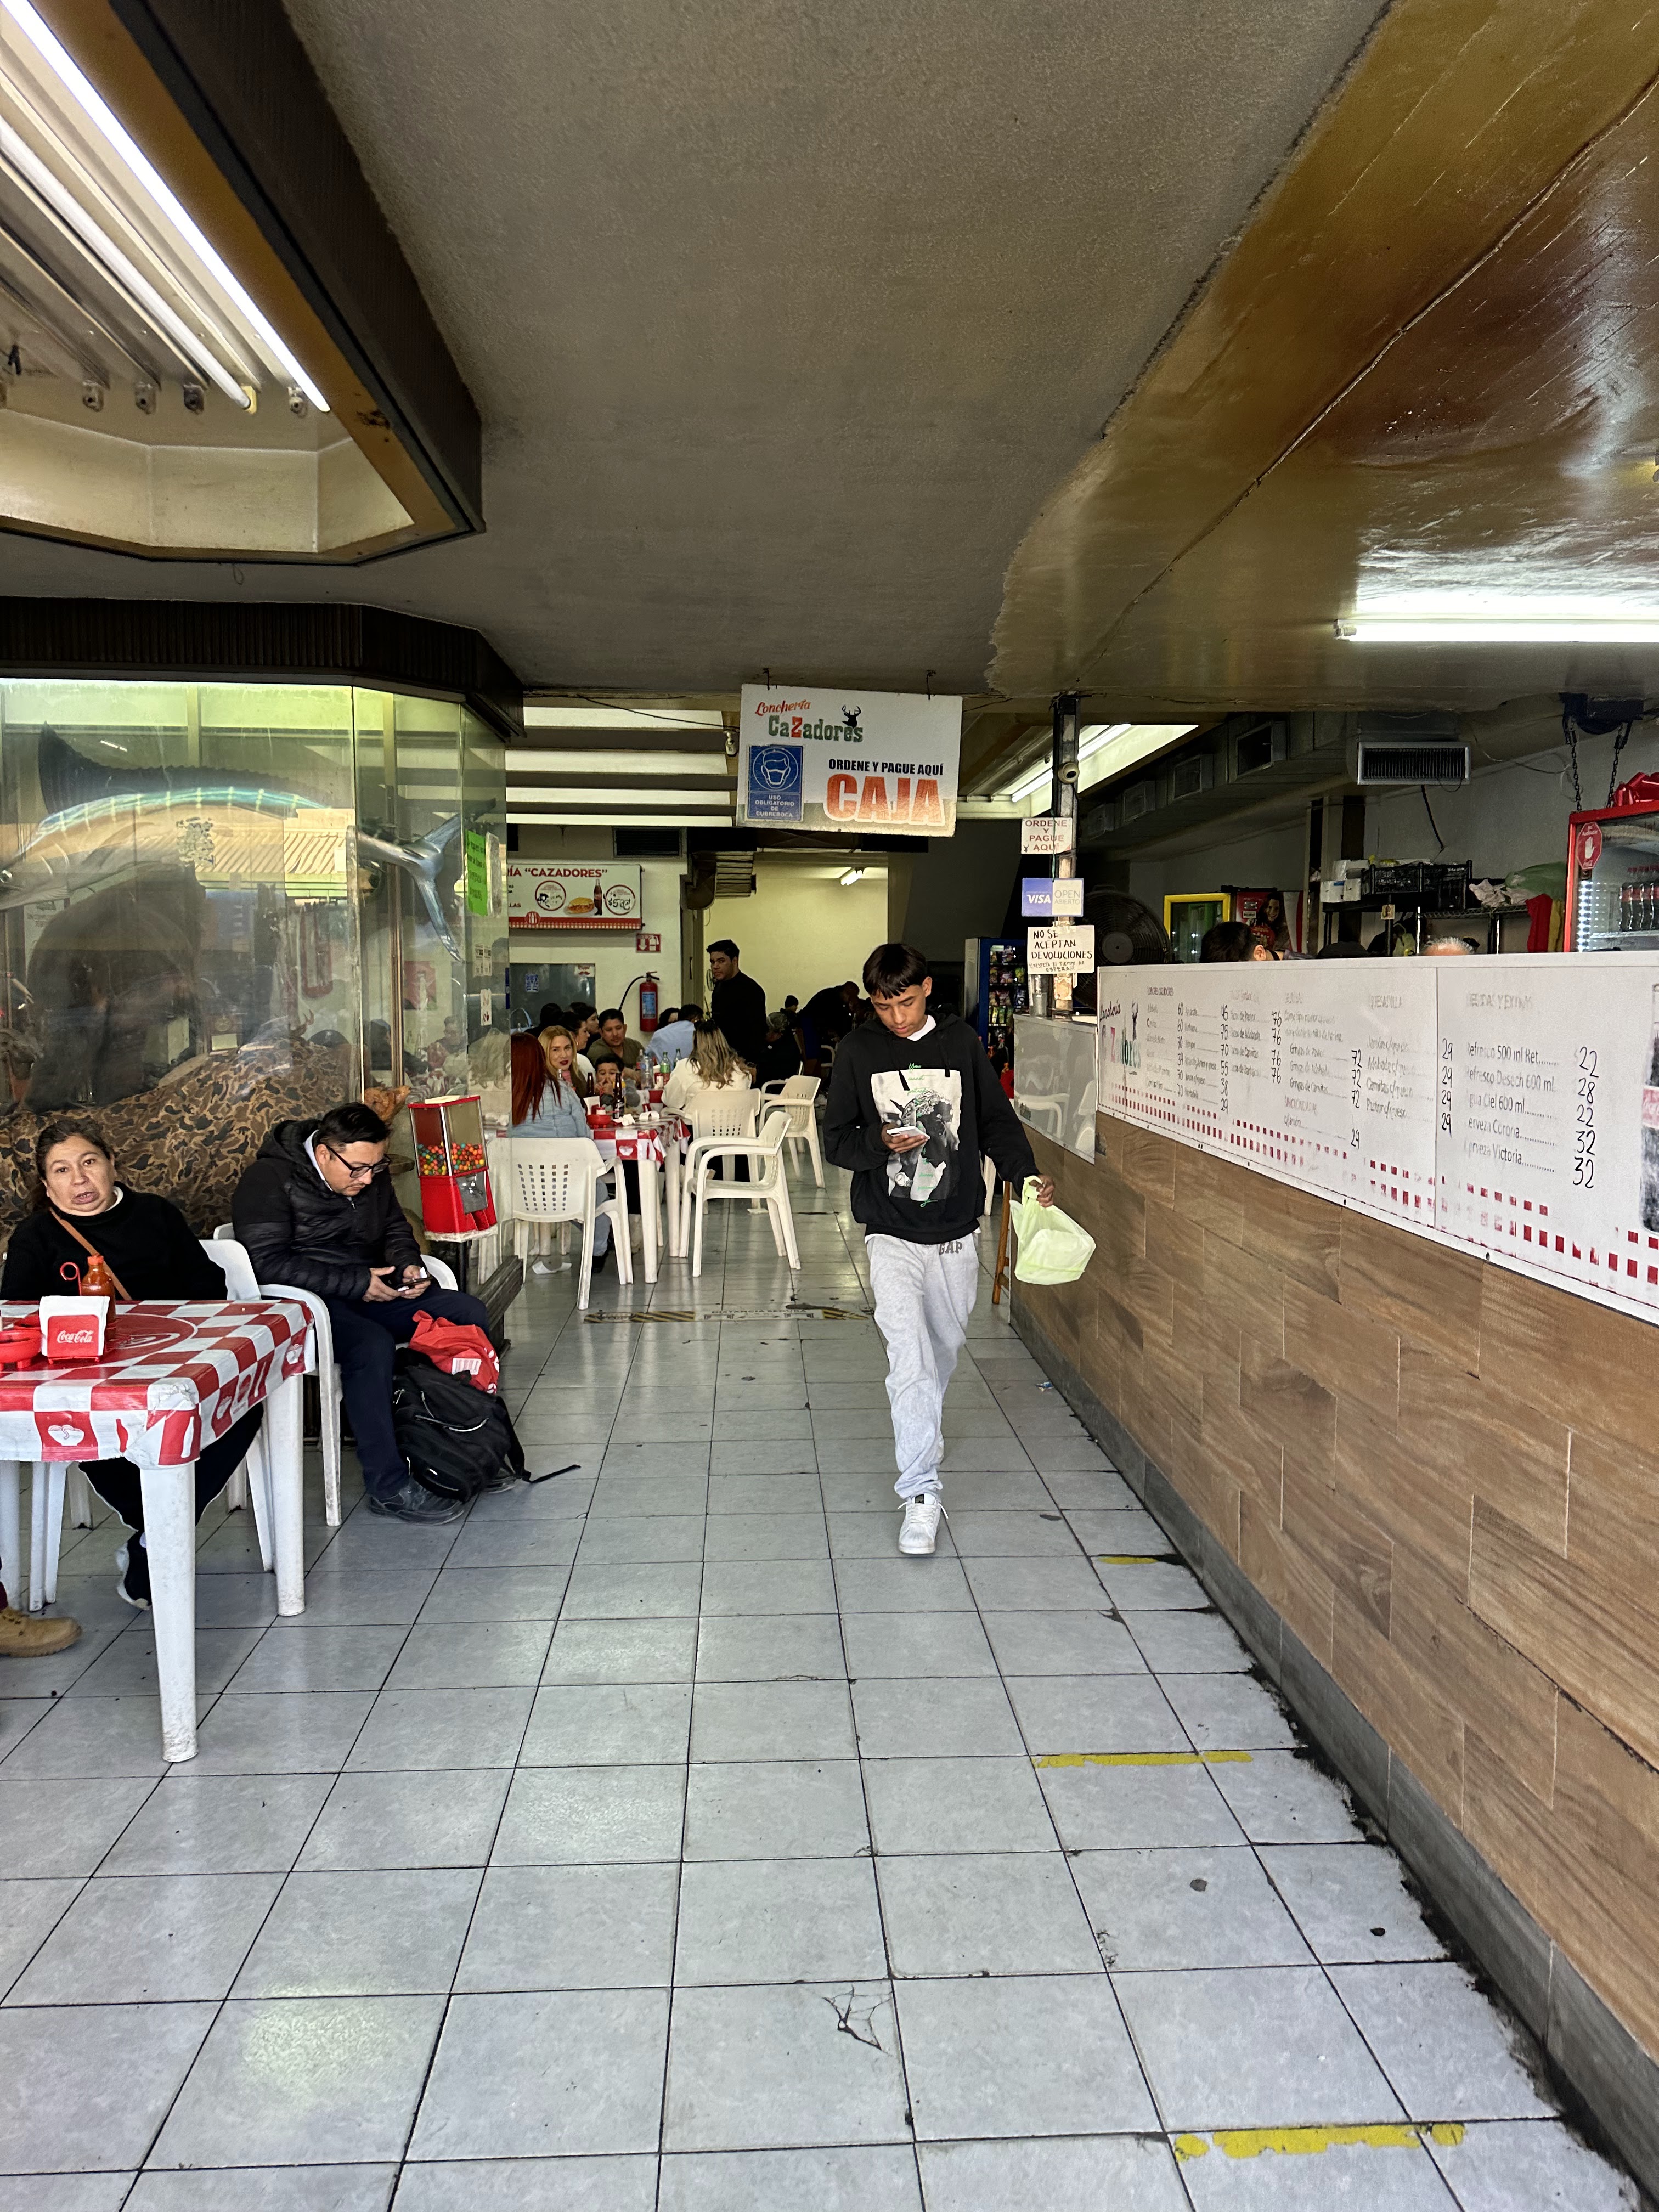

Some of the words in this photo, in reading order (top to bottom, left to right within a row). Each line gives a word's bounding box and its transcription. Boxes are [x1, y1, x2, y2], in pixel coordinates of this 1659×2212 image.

[755, 699, 811, 716] Lonchería
[768, 715, 864, 742] CaZadores
[828, 759, 870, 772] ORDENE
[872, 762, 879, 772] Y
[882, 763, 915, 774] PAGUE
[917, 763, 944, 776] AQUÍ
[826, 773, 943, 823] CAJA
[1027, 894, 1051, 904] VISA
[1054, 890, 1080, 899] OPEN
[1034, 930, 1045, 939] NO
[1047, 929, 1058, 939] SE
[1034, 939, 1076, 949] ACEPTAN
[1031, 951, 1092, 960] DEVOLUCIONES
[1178, 1002, 1184, 1016] 60
[1177, 1019, 1183, 1032] 60
[1271, 1011, 1282, 1027] 76
[1221, 1024, 1228, 1040] 75
[1271, 1028, 1281, 1045] 76
[1177, 1035, 1183, 1050] 70
[1221, 1043, 1229, 1056] 70
[1442, 1038, 1453, 1061] 29
[1467, 1041, 1496, 1059] Refreo
[1497, 1045, 1511, 1061] 500
[1271, 1050, 1281, 1066] 76
[1351, 1049, 1362, 1068] 72
[1579, 1046, 1599, 1079] 22
[1221, 1060, 1228, 1076] 55
[1271, 1067, 1281, 1084] 76
[1352, 1069, 1362, 1088] 72
[1442, 1066, 1453, 1088] 29
[1526, 1074, 1542, 1091] 600
[1177, 1083, 1183, 1097] 70
[1221, 1078, 1228, 1096] 38
[1578, 1077, 1595, 1104] 28
[1221, 1098, 1228, 1114] 29
[1351, 1090, 1359, 1109] 72
[1442, 1090, 1452, 1111] 29
[1466, 1092, 1482, 1108] gua
[1499, 1096, 1513, 1111] 600
[1468, 1117, 1491, 1130] erveza
[1577, 1104, 1594, 1127] 22
[1441, 1113, 1452, 1138] 29
[1351, 1128, 1359, 1149] 29
[1575, 1130, 1595, 1156] 32
[1464, 1139, 1491, 1158] erveza
[1572, 1156, 1594, 1189] 32
[939, 1240, 963, 1256] GAP
[57, 1330, 93, 1344] Coca-Cola
